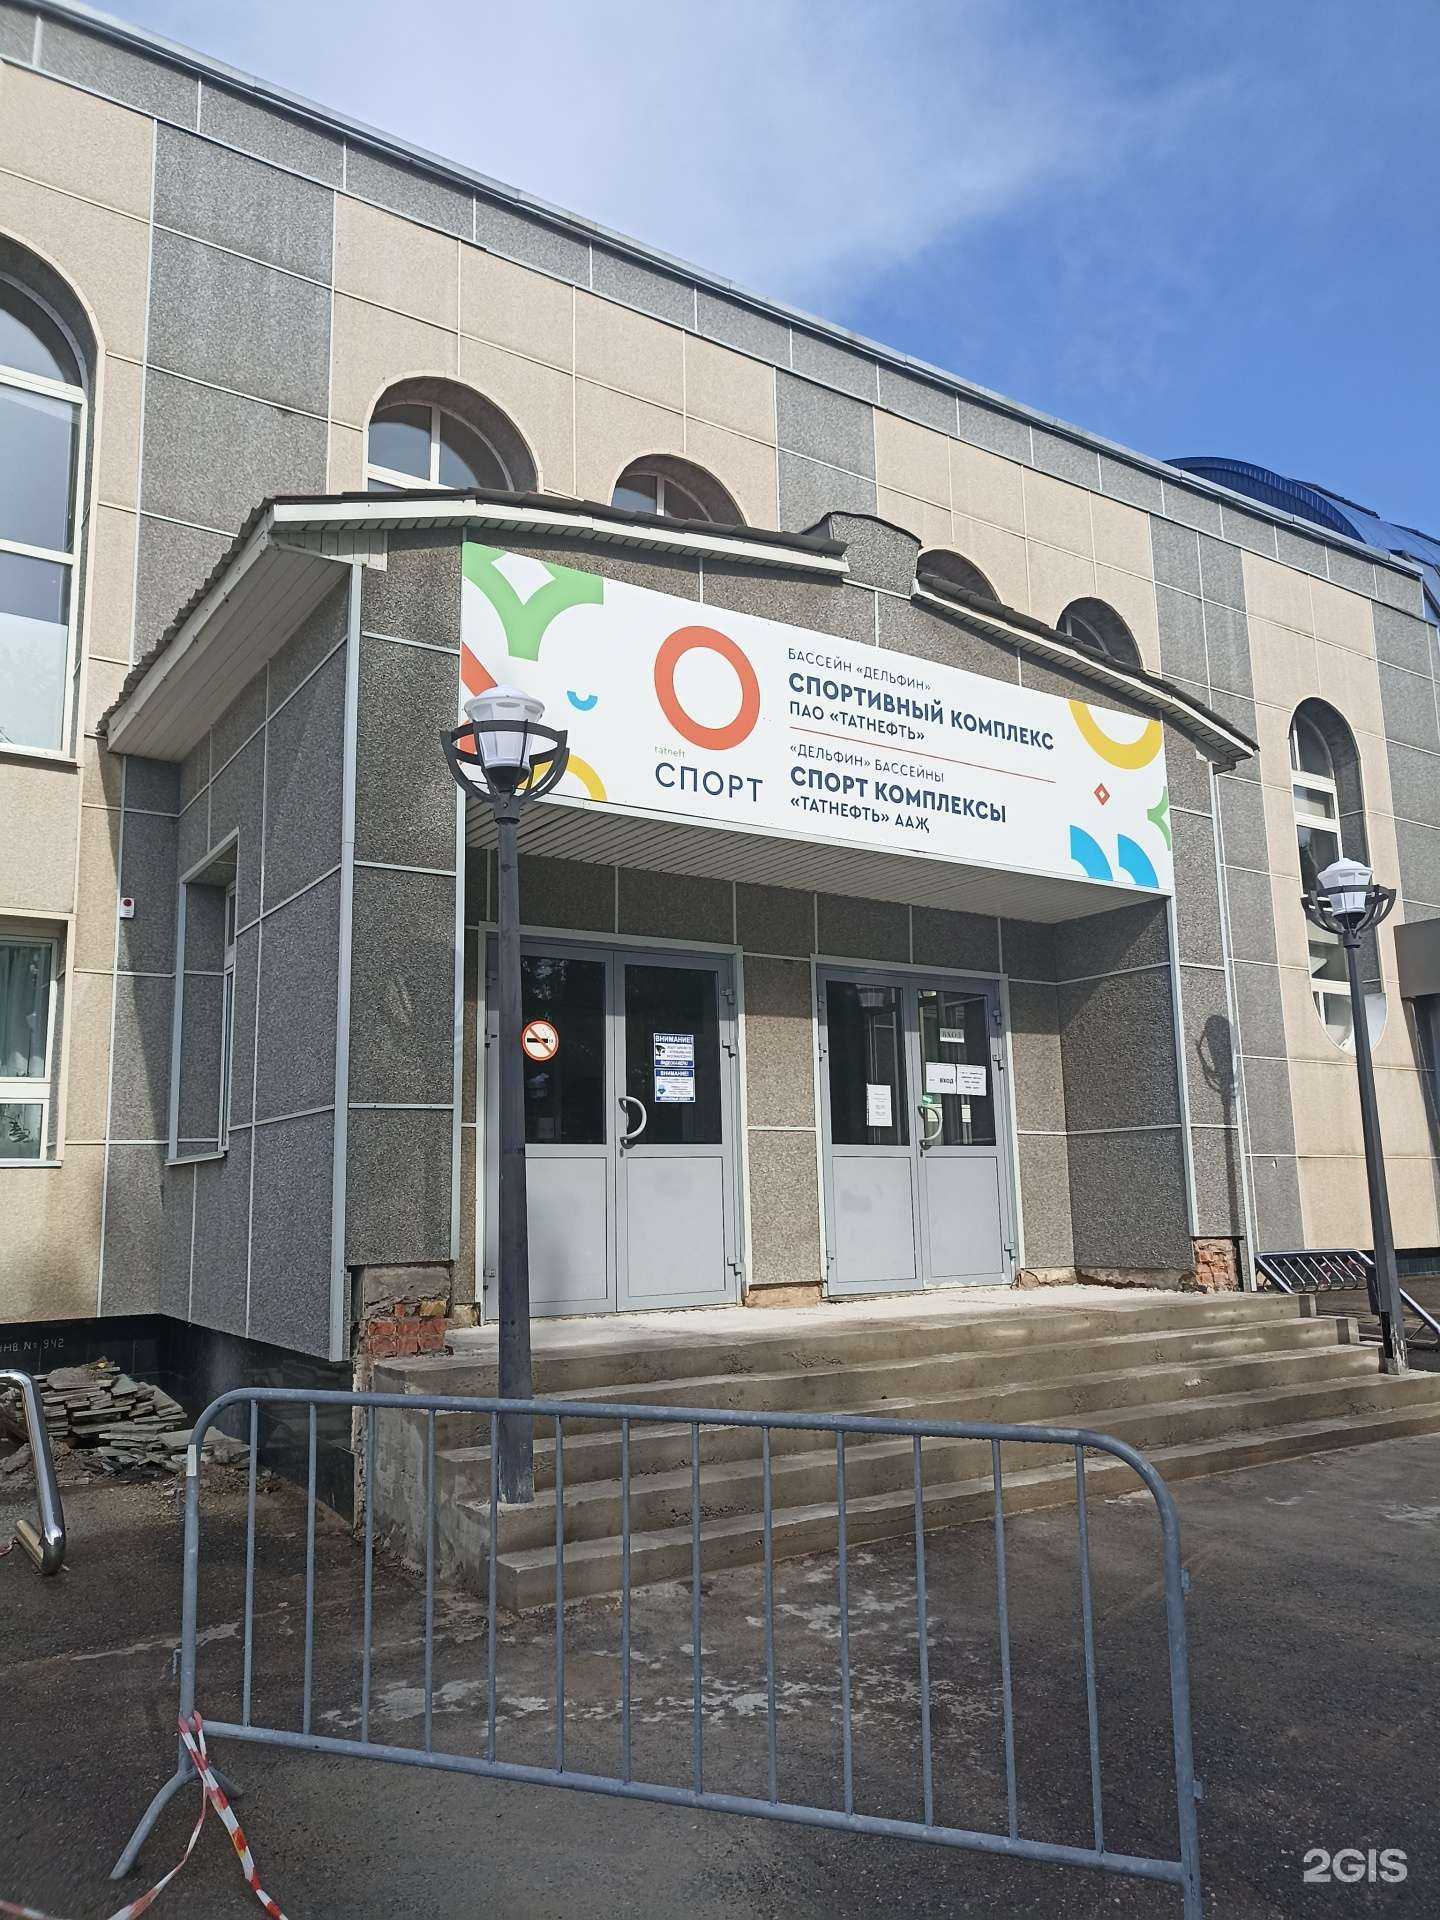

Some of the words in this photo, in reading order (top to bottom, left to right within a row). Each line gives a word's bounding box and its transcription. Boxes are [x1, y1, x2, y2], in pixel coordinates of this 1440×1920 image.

[788, 648, 852, 673] БАССЕЙН
[856, 666, 931, 691] «ДЕЛЬФИН»
[788, 672, 944, 725] СПОРТИВНЫЙ
[950, 709, 1054, 750] КОМПЛЕКС
[789, 701, 824, 721] ПАО
[830, 711, 925, 740] «ТАТНЕФТЬ»
[655, 762, 763, 802] СПОРТ
[790, 743, 871, 767] «ДЕЛЬФИН»
[875, 759, 944, 783] БАССЕЙНЫ
[790, 766, 868, 797] СПОРТ
[875, 781, 1006, 823] КОМПЛЕКСЫ
[790, 796, 889, 823] «ТАТНЕФТЬ»
